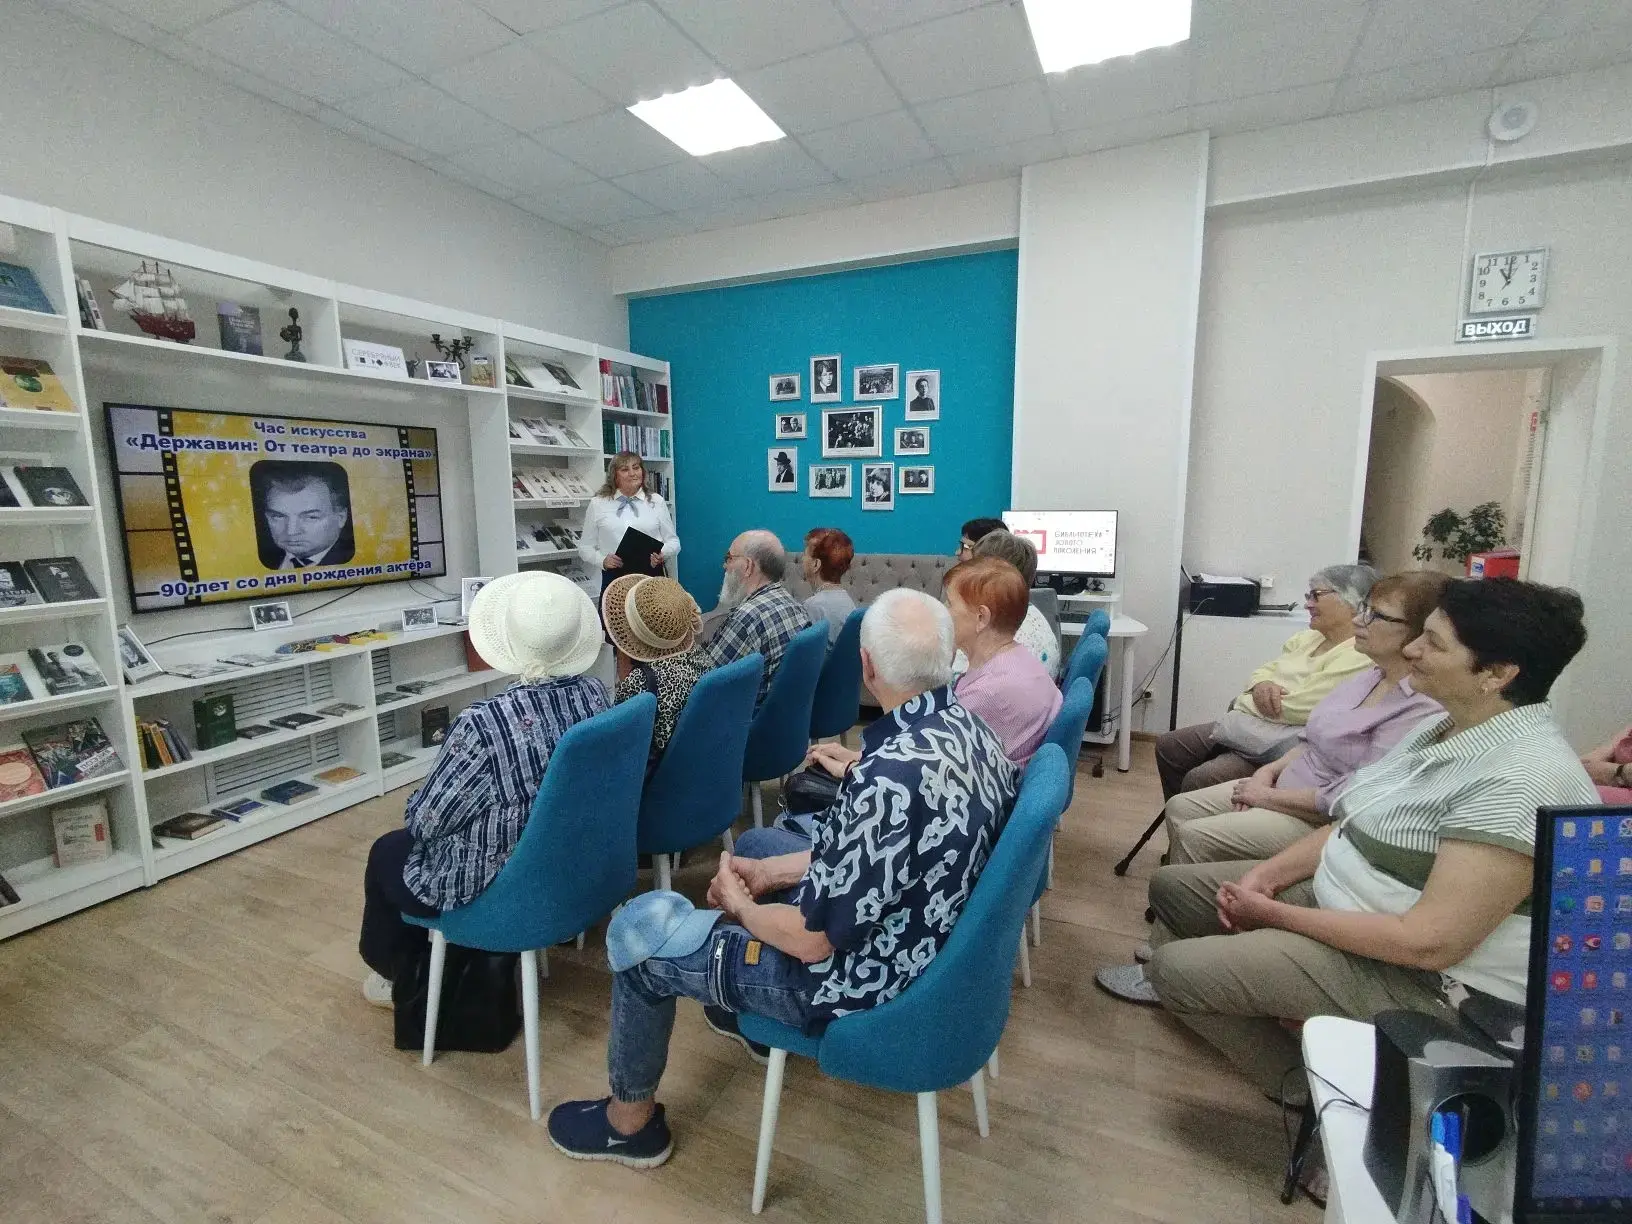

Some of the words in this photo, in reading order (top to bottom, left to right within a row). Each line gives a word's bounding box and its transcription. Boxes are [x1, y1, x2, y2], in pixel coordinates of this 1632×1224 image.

[1531, 262, 1538, 270] 2
[1464, 320, 1526, 336] ВЫХОД
[254, 421, 286, 434] Час
[291, 426, 367, 439] искусства
[126, 433, 258, 452] «Державин:
[264, 439, 287, 453] От
[291, 442, 347, 457] театра
[352, 449, 371, 457] до
[375, 447, 432, 459] экрана»
[160, 583, 187, 597] 90
[194, 580, 230, 593] лет
[236, 578, 259, 589] со
[264, 574, 297, 588] дня
[302, 564, 382, 584] рождения
[386, 559, 432, 574] актёра
